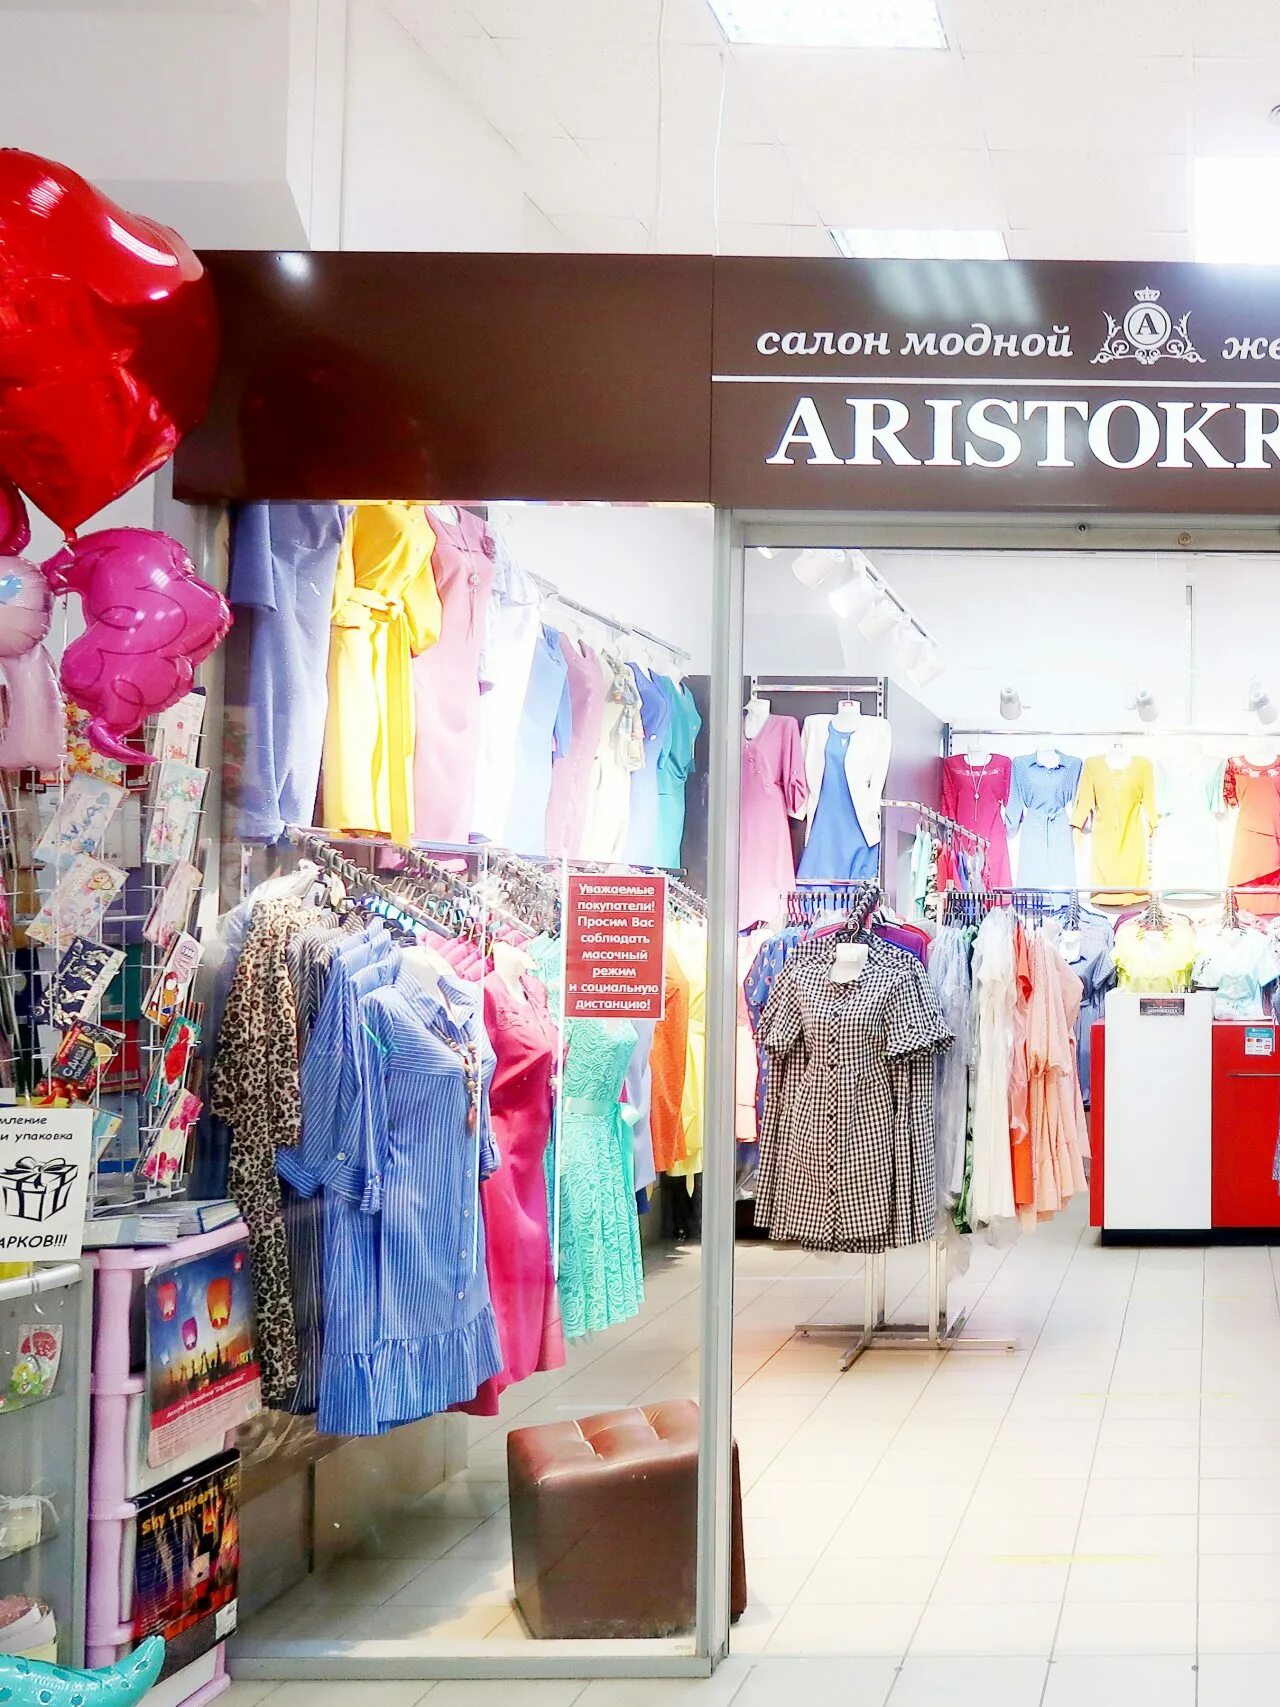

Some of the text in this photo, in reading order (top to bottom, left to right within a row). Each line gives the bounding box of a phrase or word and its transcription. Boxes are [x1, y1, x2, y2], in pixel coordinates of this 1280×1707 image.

[756, 331, 891, 355] салон
[900, 323, 1074, 357] модной
[579, 883, 655, 895] Уважаемые
[577, 901, 655, 913] покупатели!
[577, 915, 655, 929] Просим Вас
[580, 932, 651, 945] соблюдать
[582, 949, 648, 960] масочный
[592, 967, 637, 978] режим
[568, 983, 659, 996] и социальную
[575, 999, 651, 1011] дистанцию!
[15, 1133, 73, 1143] упаковка
